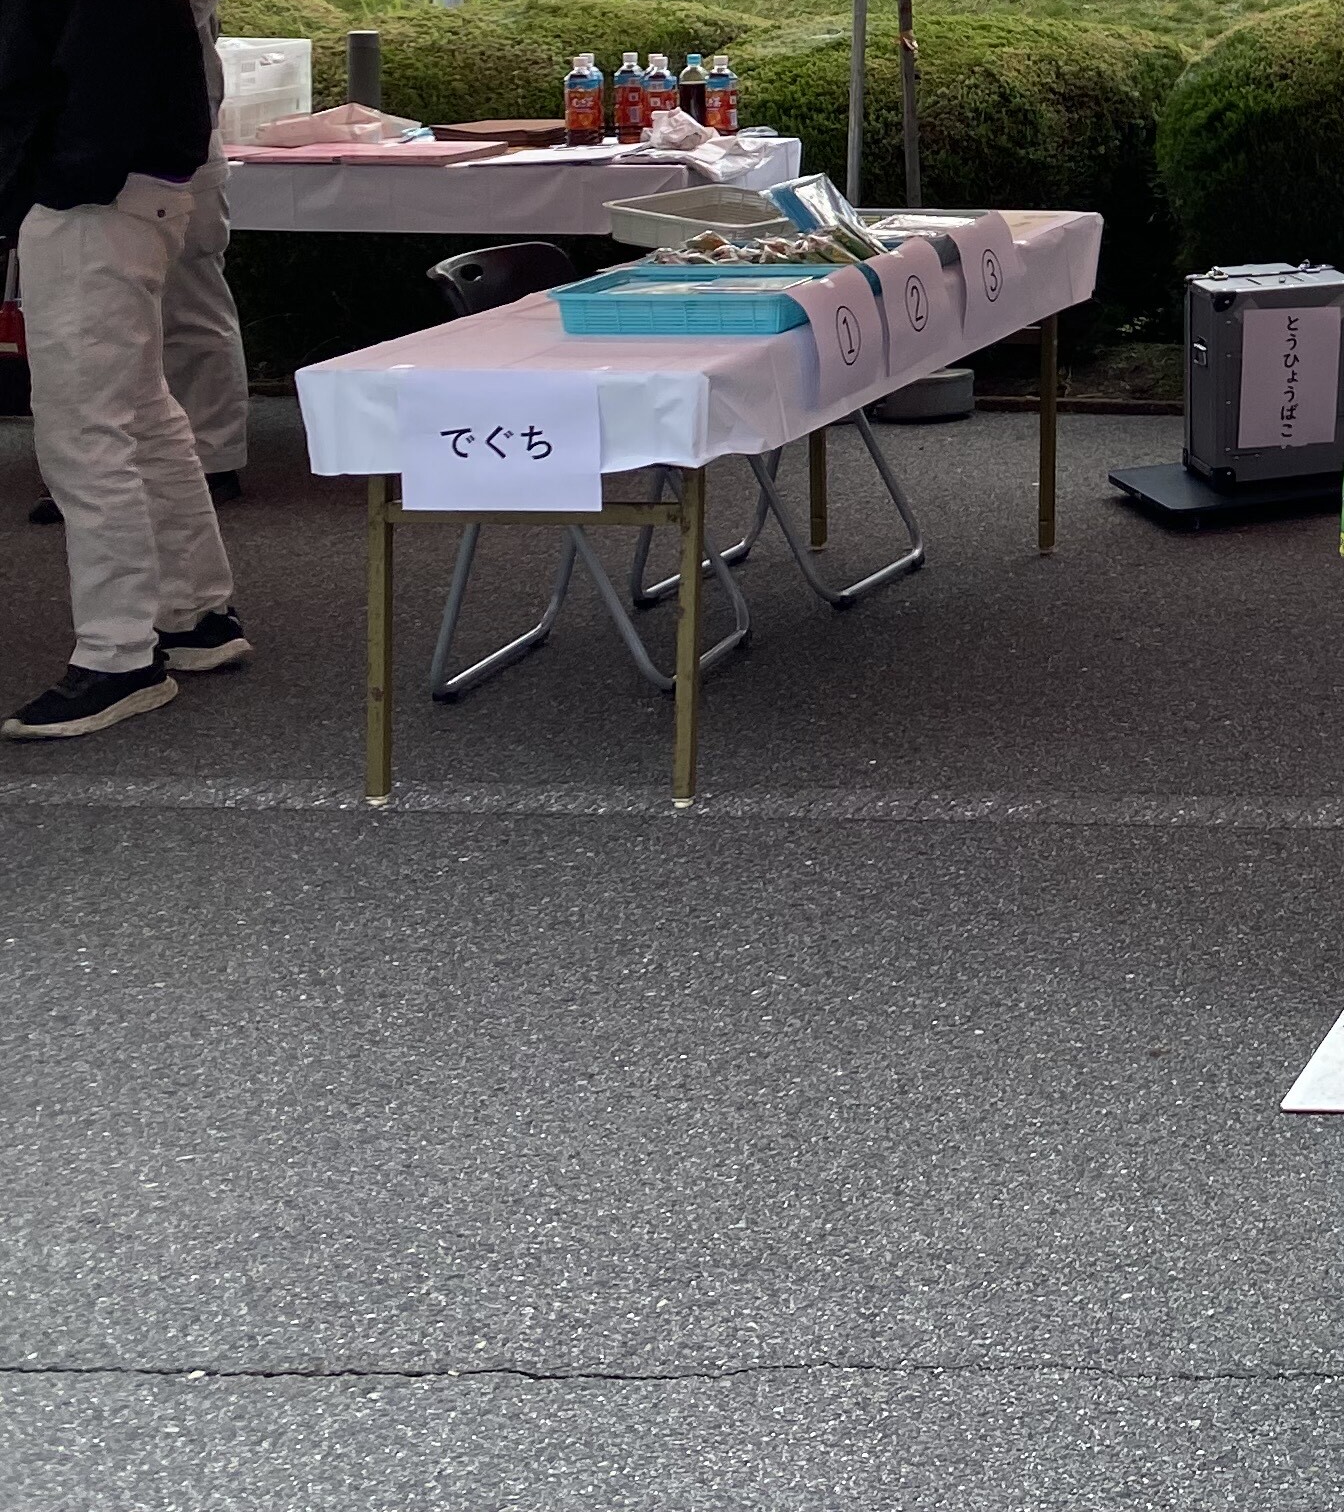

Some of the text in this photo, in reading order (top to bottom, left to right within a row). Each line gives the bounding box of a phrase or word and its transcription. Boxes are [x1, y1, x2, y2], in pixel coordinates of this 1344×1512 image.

[1280, 315, 1301, 438] とうひょうばこ
[440, 424, 555, 462] でぐち
